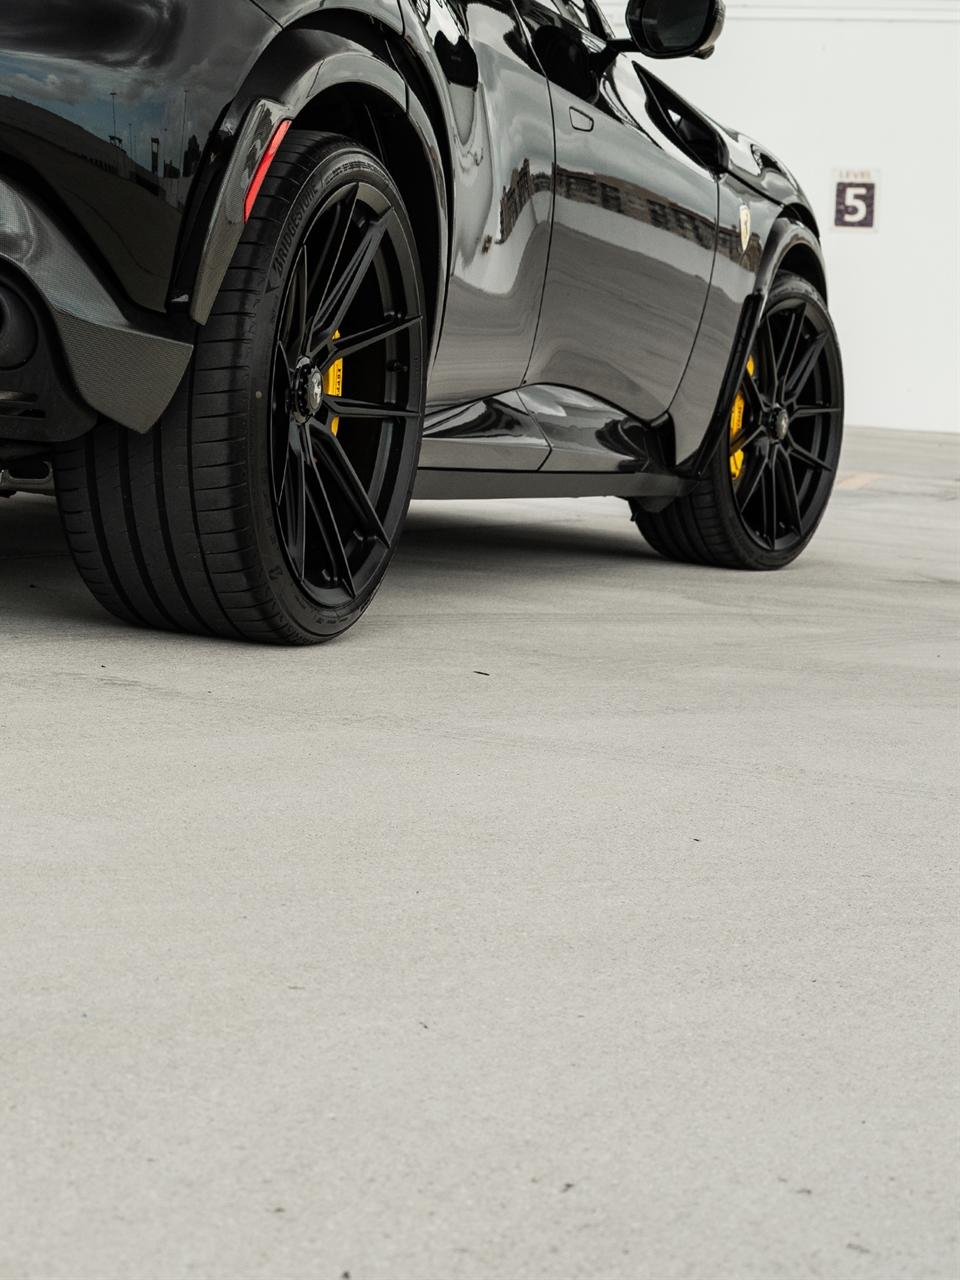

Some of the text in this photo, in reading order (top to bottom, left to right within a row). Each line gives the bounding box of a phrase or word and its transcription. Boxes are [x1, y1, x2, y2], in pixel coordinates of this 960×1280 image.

[839, 169, 871, 179] LEVEL
[844, 187, 867, 222] 5
[273, 182, 319, 278] BRIDGESTONE
